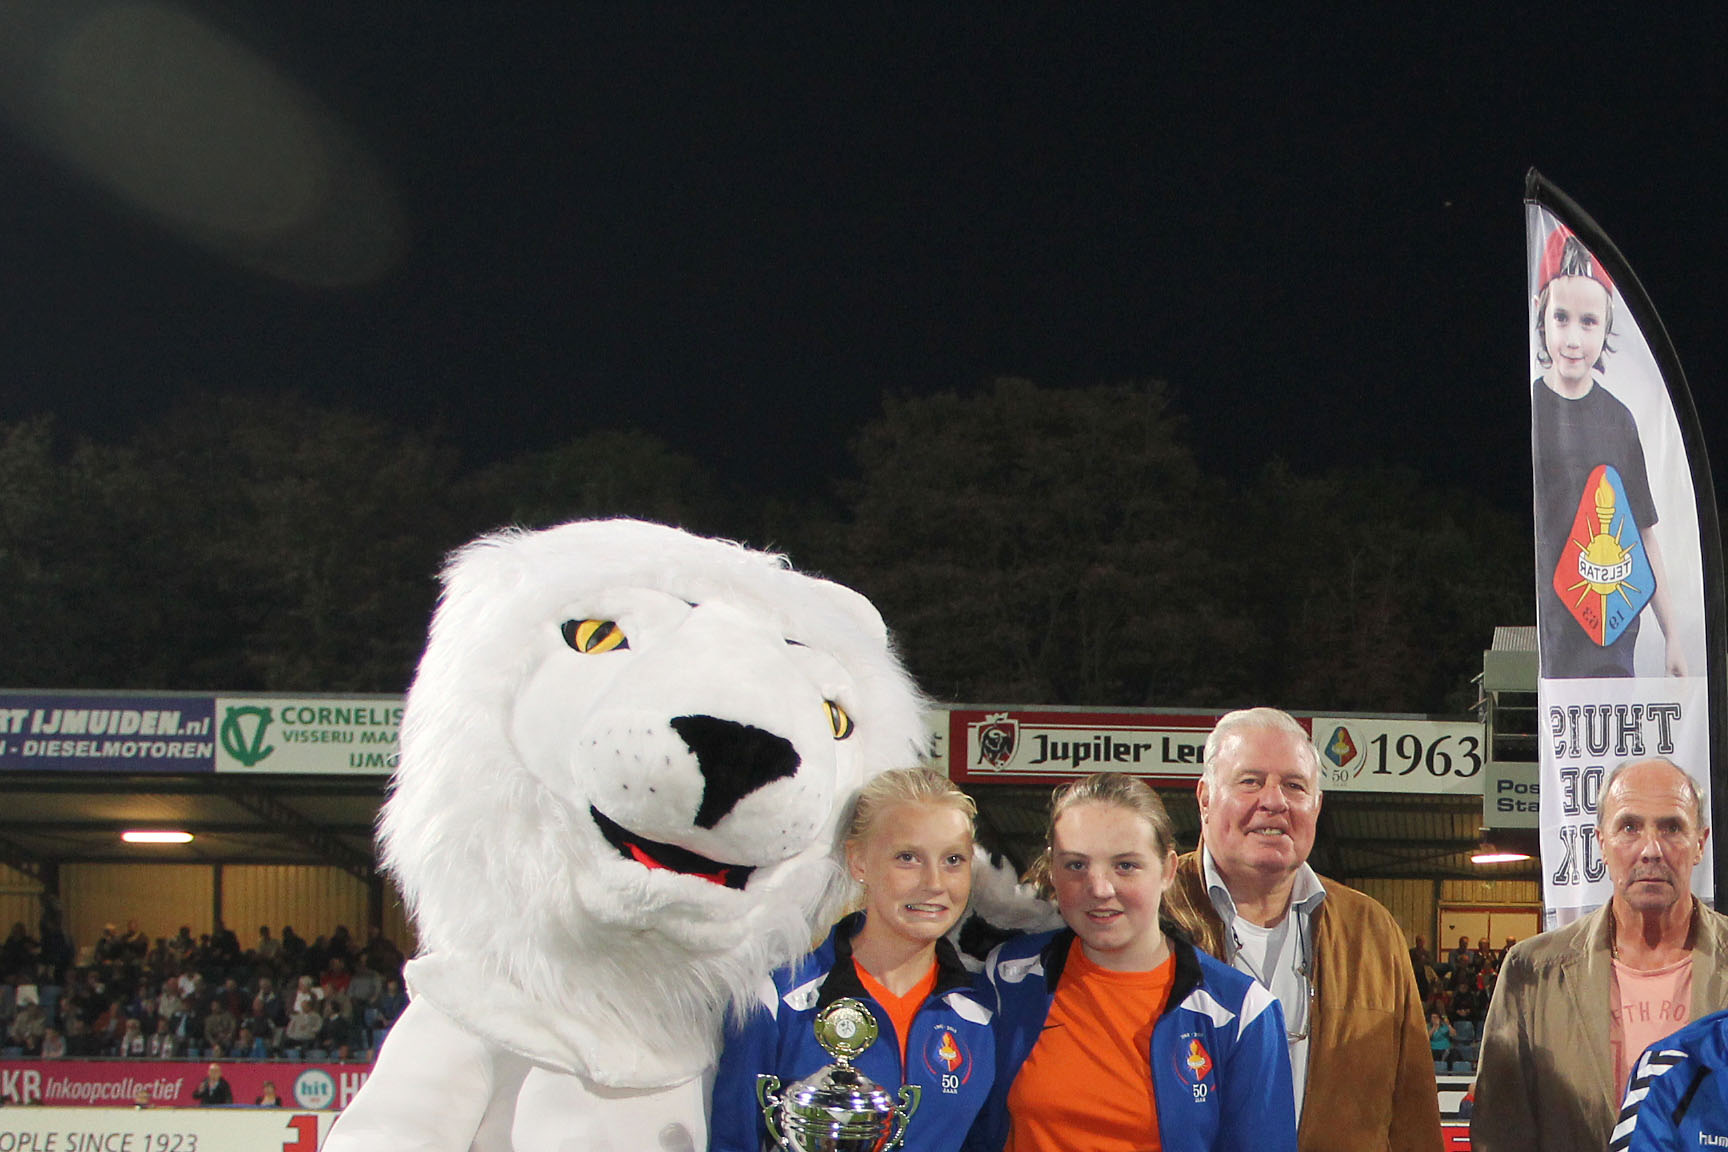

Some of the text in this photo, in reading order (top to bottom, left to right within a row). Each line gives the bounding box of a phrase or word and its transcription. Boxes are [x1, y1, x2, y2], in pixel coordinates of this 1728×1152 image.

[31, 709, 211, 736] IJMUIDEN.nl
[280, 706, 404, 726] CORNELIS
[281, 730, 354, 744] VISSERIJ
[23, 740, 214, 758] DIESELMOTOREN
[1028, 734, 1152, 768] Jupiler
[1370, 733, 1482, 778] 1963
[1331, 769, 1349, 783] 50
[45, 1076, 185, 1104] Inkoopcollectief
[301, 1080, 329, 1096] hit
[941, 1074, 959, 1089] 50
[1192, 1083, 1208, 1098] 50
[0, 1131, 59, 1152] OPLE
